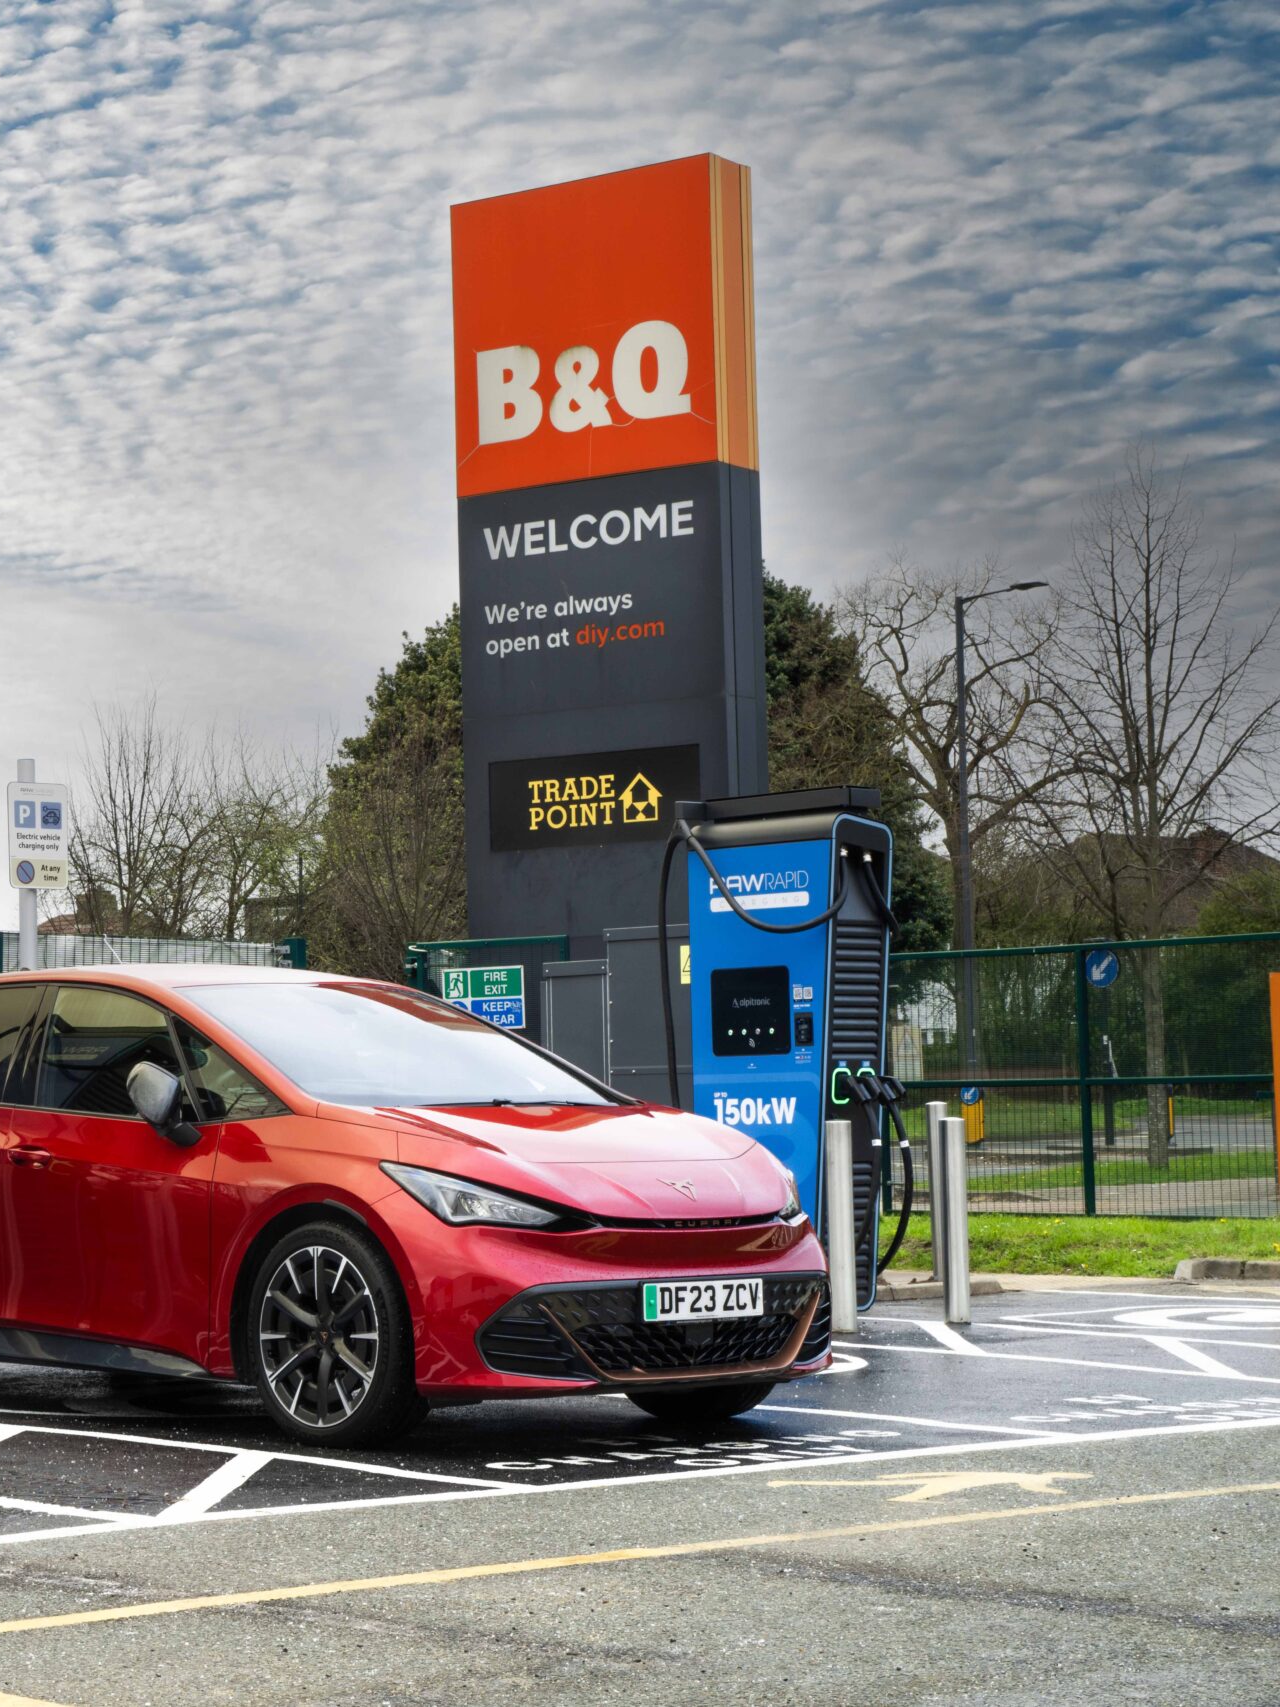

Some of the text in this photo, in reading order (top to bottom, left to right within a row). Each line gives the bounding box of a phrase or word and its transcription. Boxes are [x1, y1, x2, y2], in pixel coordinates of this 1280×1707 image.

[476, 320, 691, 446] B&Q
[483, 500, 694, 560] WELCOME
[484, 594, 632, 625] We're always
[486, 620, 665, 658] open at diy.com
[528, 774, 615, 803] TRADE
[19, 805, 30, 824] P
[529, 801, 615, 830] POINT
[16, 832, 60, 841] Electric vehicle
[18, 843, 59, 851] charging only
[40, 864, 60, 874] At any
[484, 971, 508, 982] FIRE
[484, 984, 508, 995] EXIT
[481, 1014, 515, 1024] EAR
[482, 1001, 511, 1012] KEEP
[714, 1097, 797, 1125] 150kW
[660, 1282, 759, 1314] DF23 ZCV
[485, 1430, 901, 1470] CHARGING
[674, 1444, 873, 1466] ONLY
